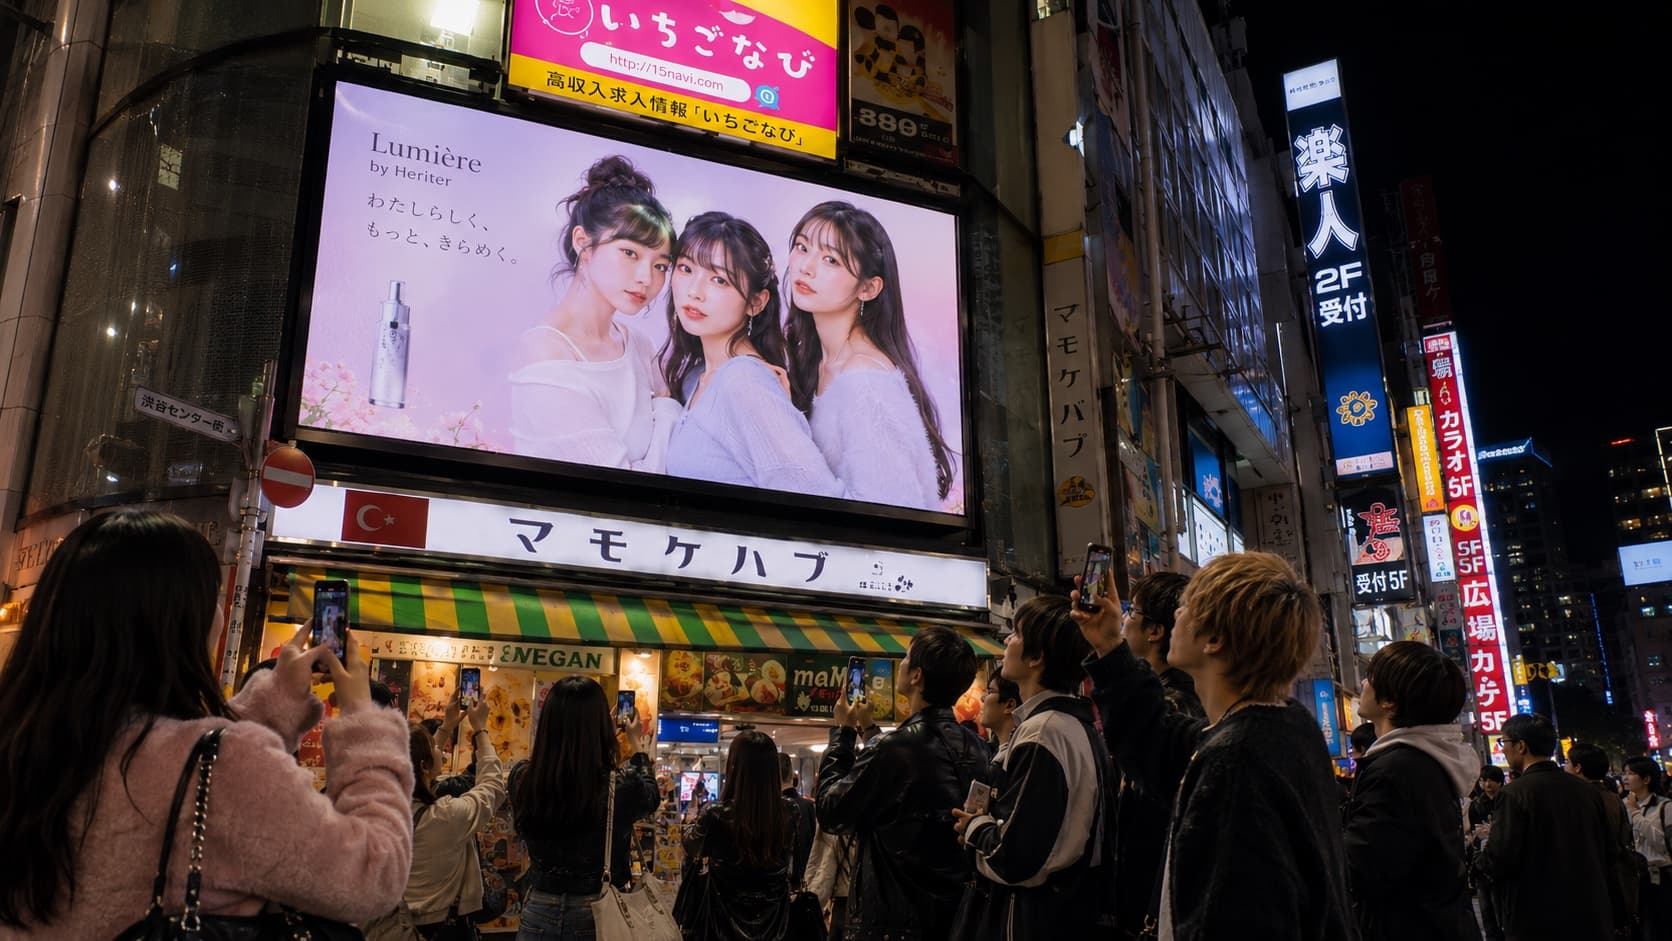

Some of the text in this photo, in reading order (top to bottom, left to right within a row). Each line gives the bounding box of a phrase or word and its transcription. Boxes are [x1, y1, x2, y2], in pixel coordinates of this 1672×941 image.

[601, 4, 816, 78] いちごなび
[609, 53, 723, 92] http://15navi.com
[371, 131, 482, 173] Lumière
[370, 160, 452, 186] by Heriter
[1294, 123, 1359, 259] 楽人
[367, 193, 488, 231] わたしらしく、
[367, 222, 517, 265] もっと、きらめく。
[1315, 261, 1363, 294] 2F
[1319, 292, 1367, 327] 受付
[142, 394, 225, 433] 渋谷センター街
[509, 517, 829, 583] マモケハブ
